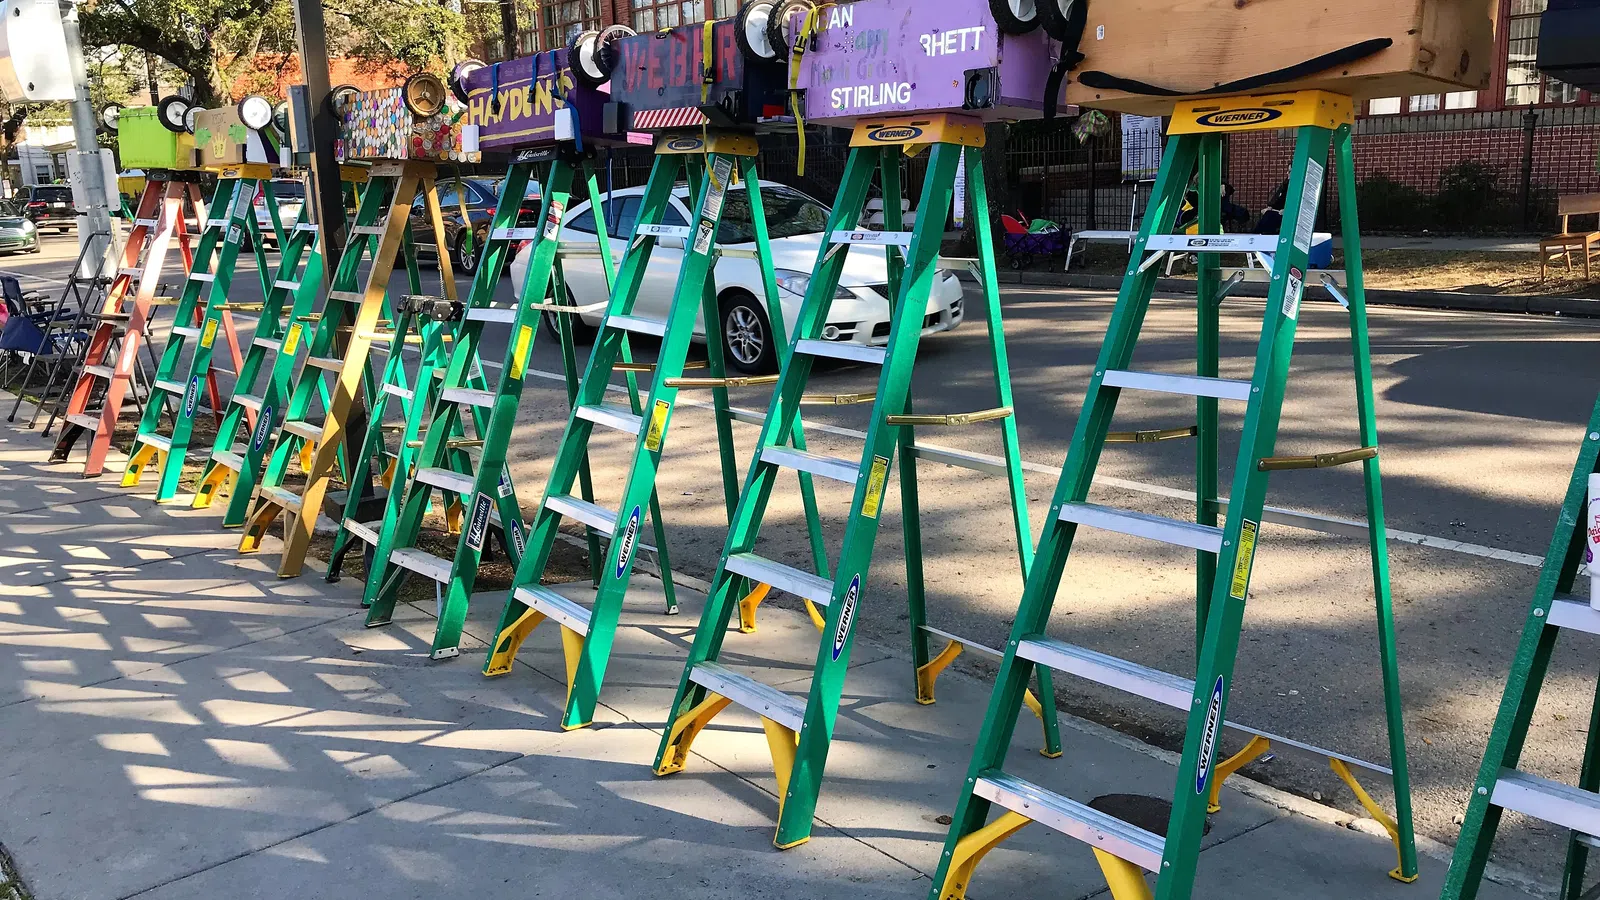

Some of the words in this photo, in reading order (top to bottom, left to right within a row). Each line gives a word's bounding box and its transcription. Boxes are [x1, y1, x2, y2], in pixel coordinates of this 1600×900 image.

[919, 25, 985, 57] RHETT
[831, 82, 911, 109] STIRLING
[1214, 112, 1265, 122] WERNER
[878, 129, 913, 139] WERNER
[187, 383, 197, 409] WERNER
[257, 414, 270, 442] WERNER
[620, 520, 637, 563] WERNER
[836, 590, 857, 644] WERNER
[1200, 698, 1221, 771] WERNER
